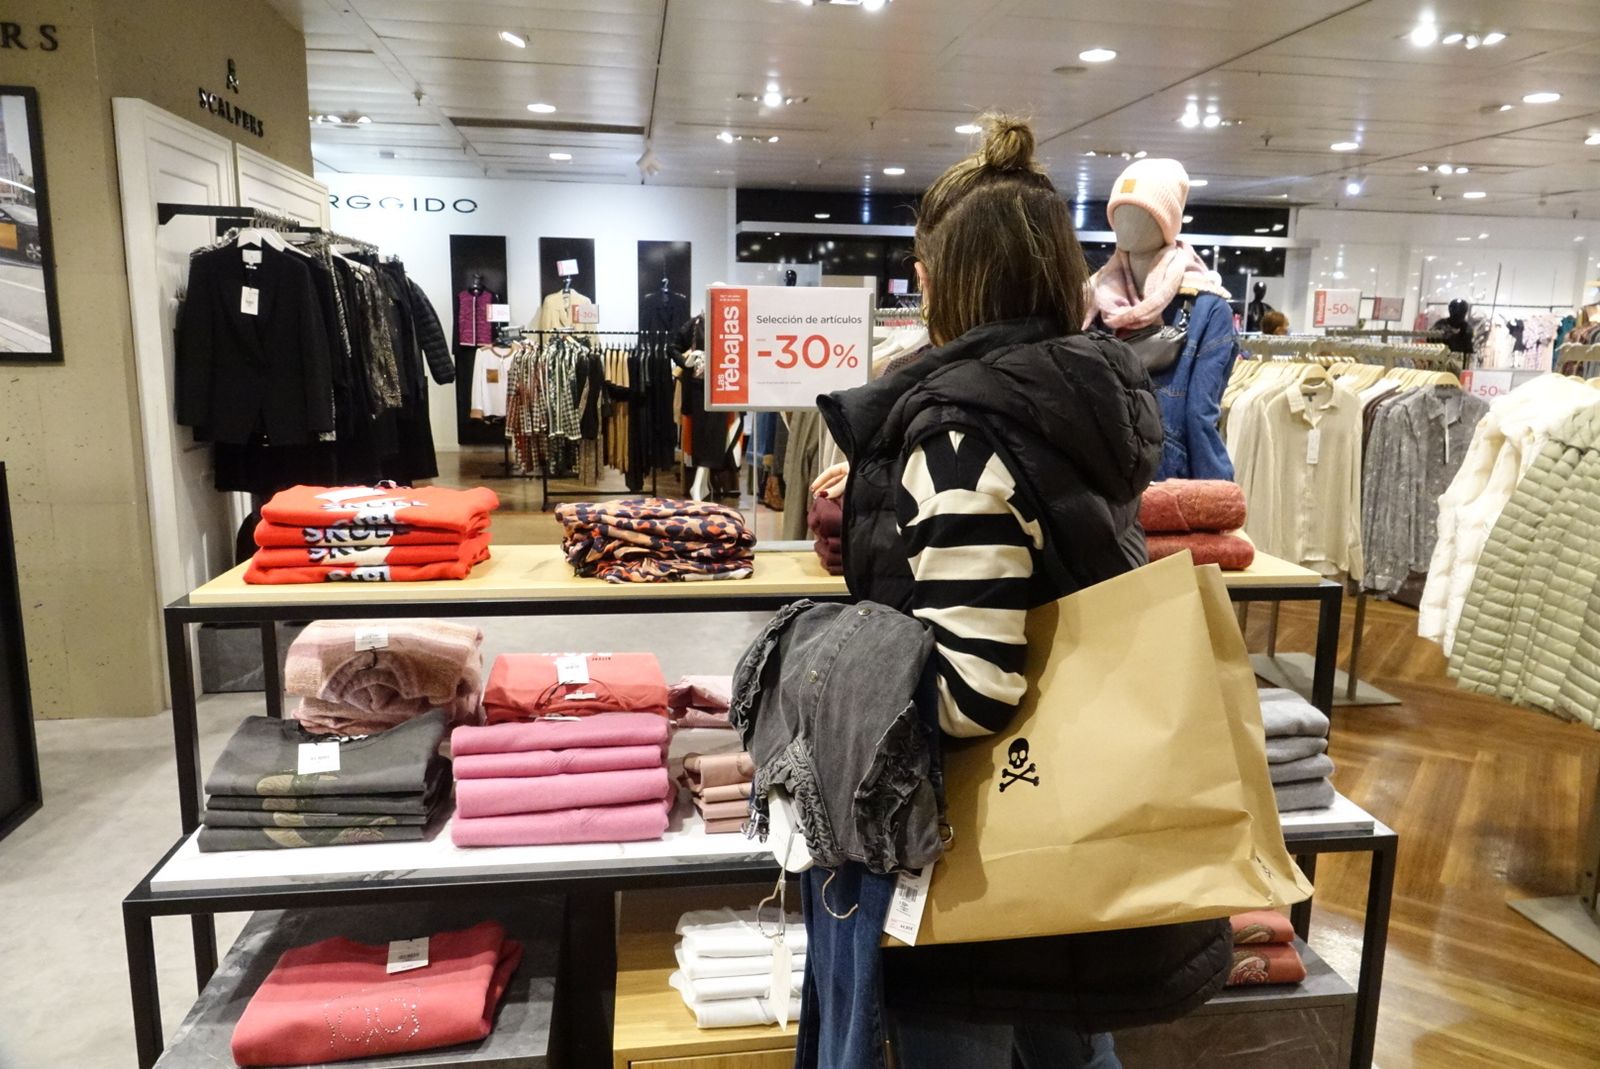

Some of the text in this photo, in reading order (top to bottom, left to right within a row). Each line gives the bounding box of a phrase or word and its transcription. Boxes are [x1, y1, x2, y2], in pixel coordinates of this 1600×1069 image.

[198, 87, 264, 138] SCALPERS
[756, 314, 803, 325] Selección
[806, 314, 818, 325] de
[820, 314, 863, 325] artículos
[719, 305, 744, 391] rebajas
[757, 334, 858, 369] -30%
